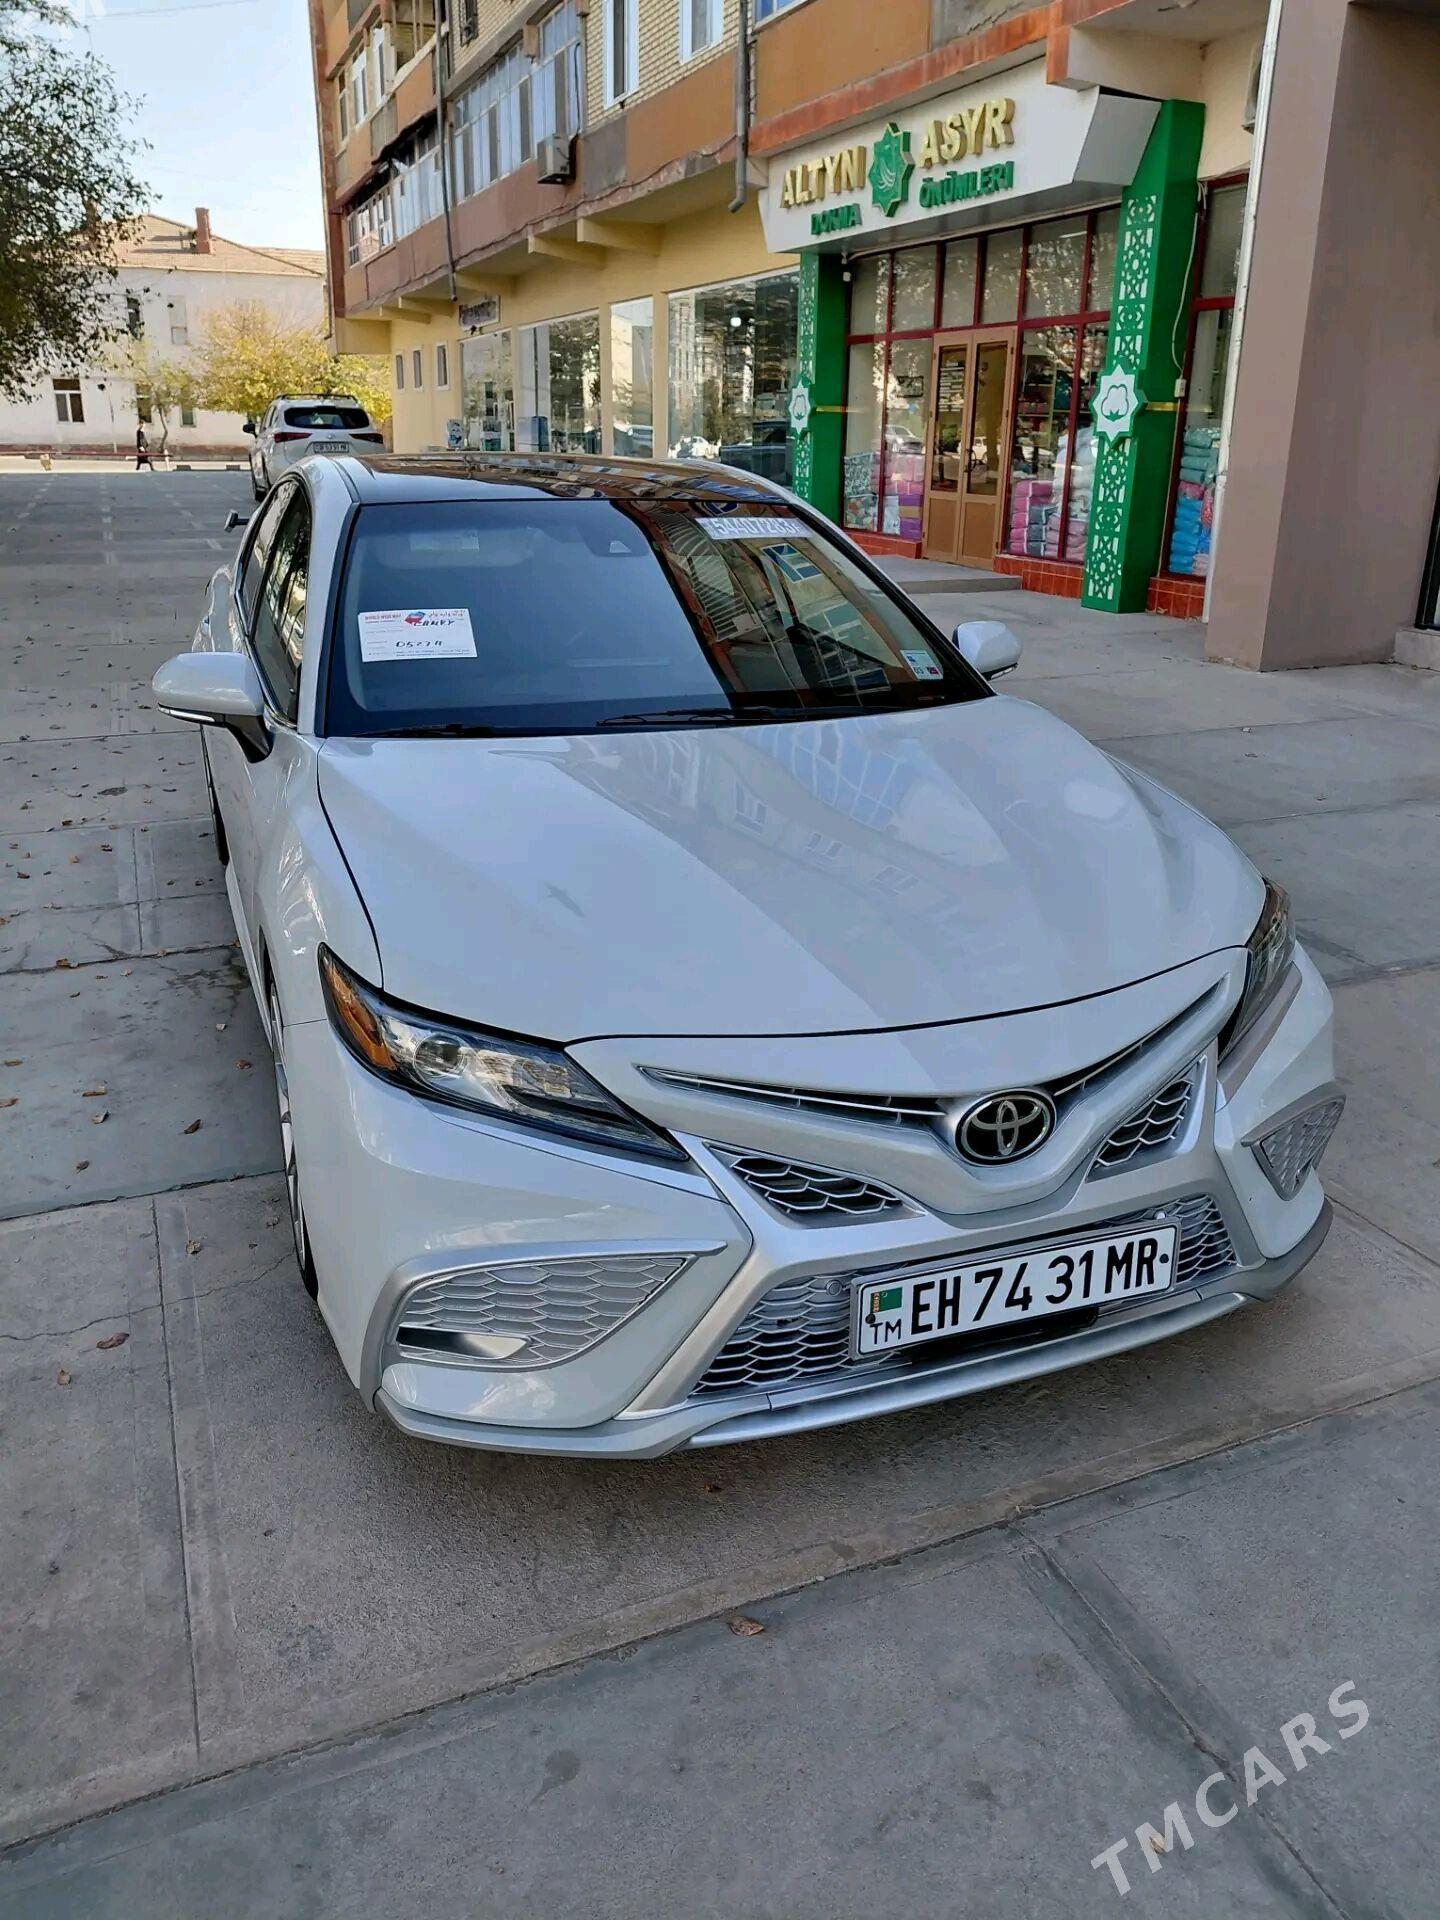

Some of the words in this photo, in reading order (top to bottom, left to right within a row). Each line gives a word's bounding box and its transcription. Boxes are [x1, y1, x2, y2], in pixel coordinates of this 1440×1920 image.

[781, 146, 866, 208] ALTYN
[918, 98, 1015, 169] ASYR
[872, 1319, 901, 1344] TM
